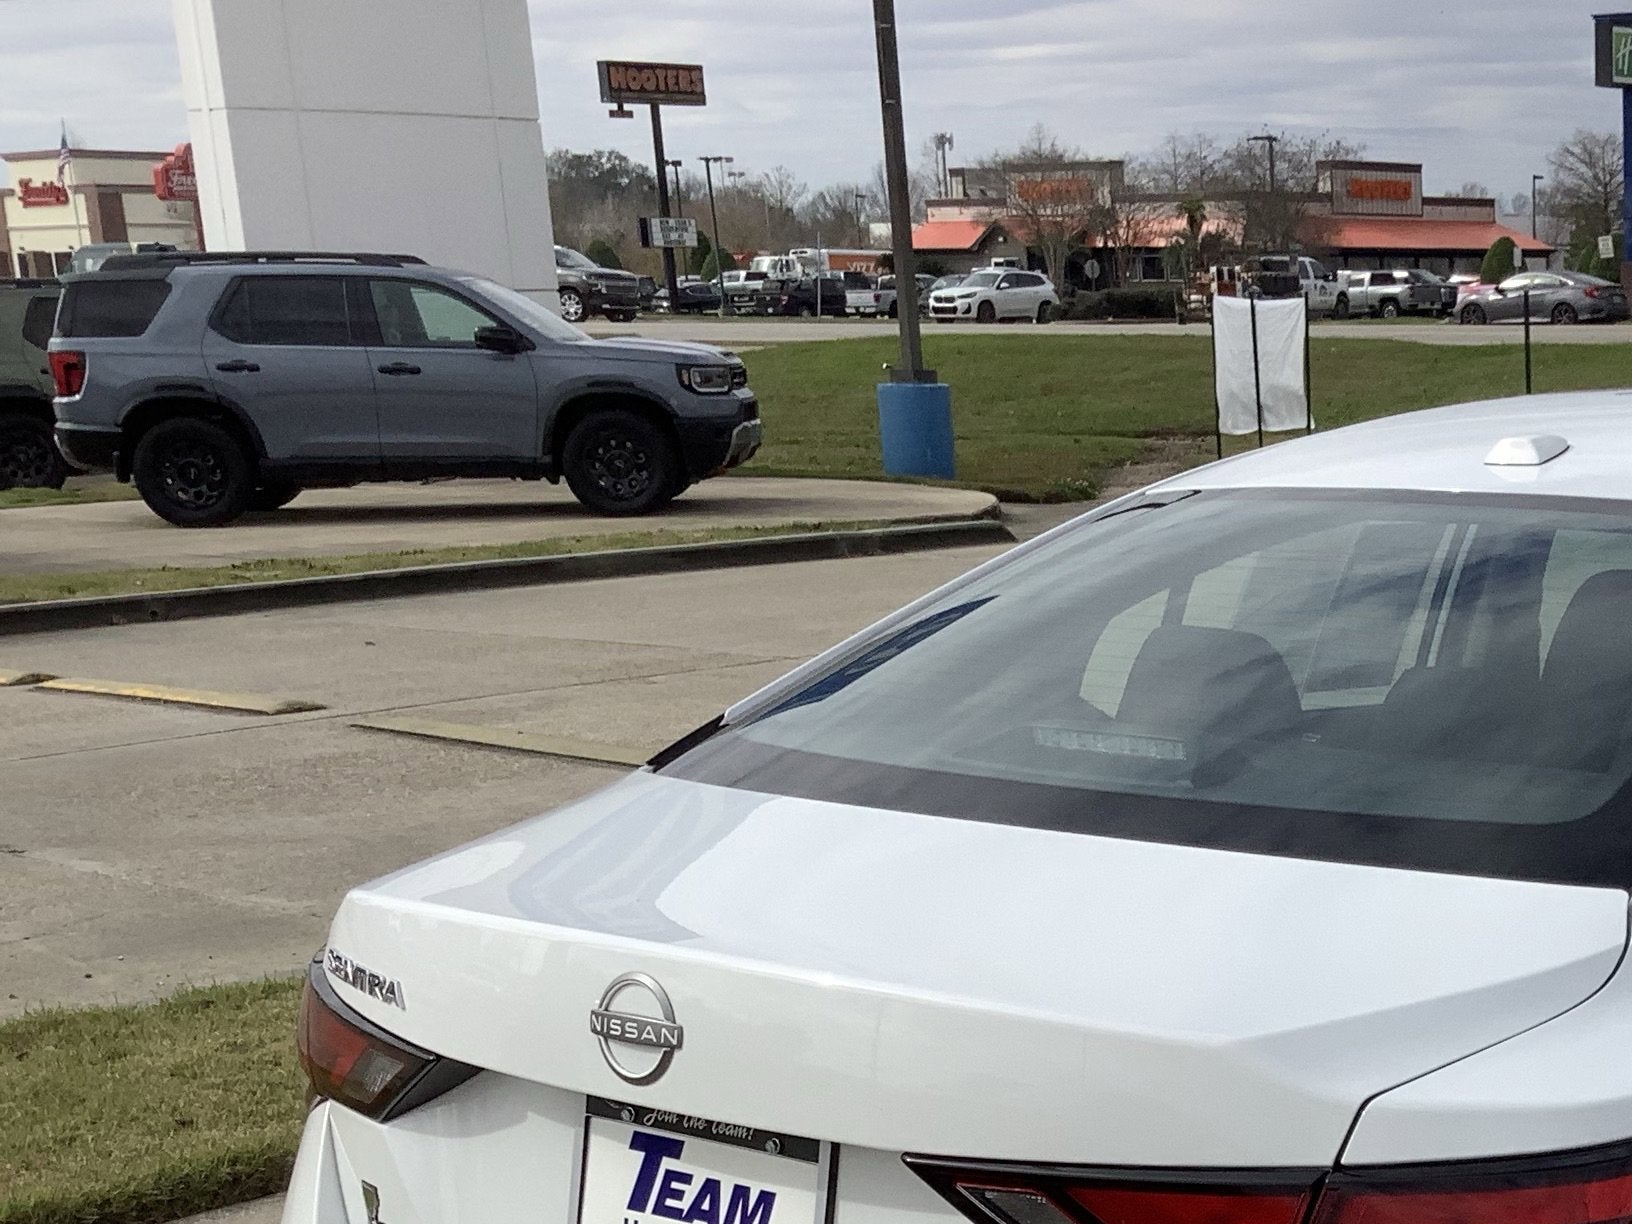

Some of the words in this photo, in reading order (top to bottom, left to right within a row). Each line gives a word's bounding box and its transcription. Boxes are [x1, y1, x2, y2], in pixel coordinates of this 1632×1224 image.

[609, 65, 703, 93] HOOTERS
[328, 948, 406, 1010] SENTRA
[591, 1014, 678, 1046] NISSAN
